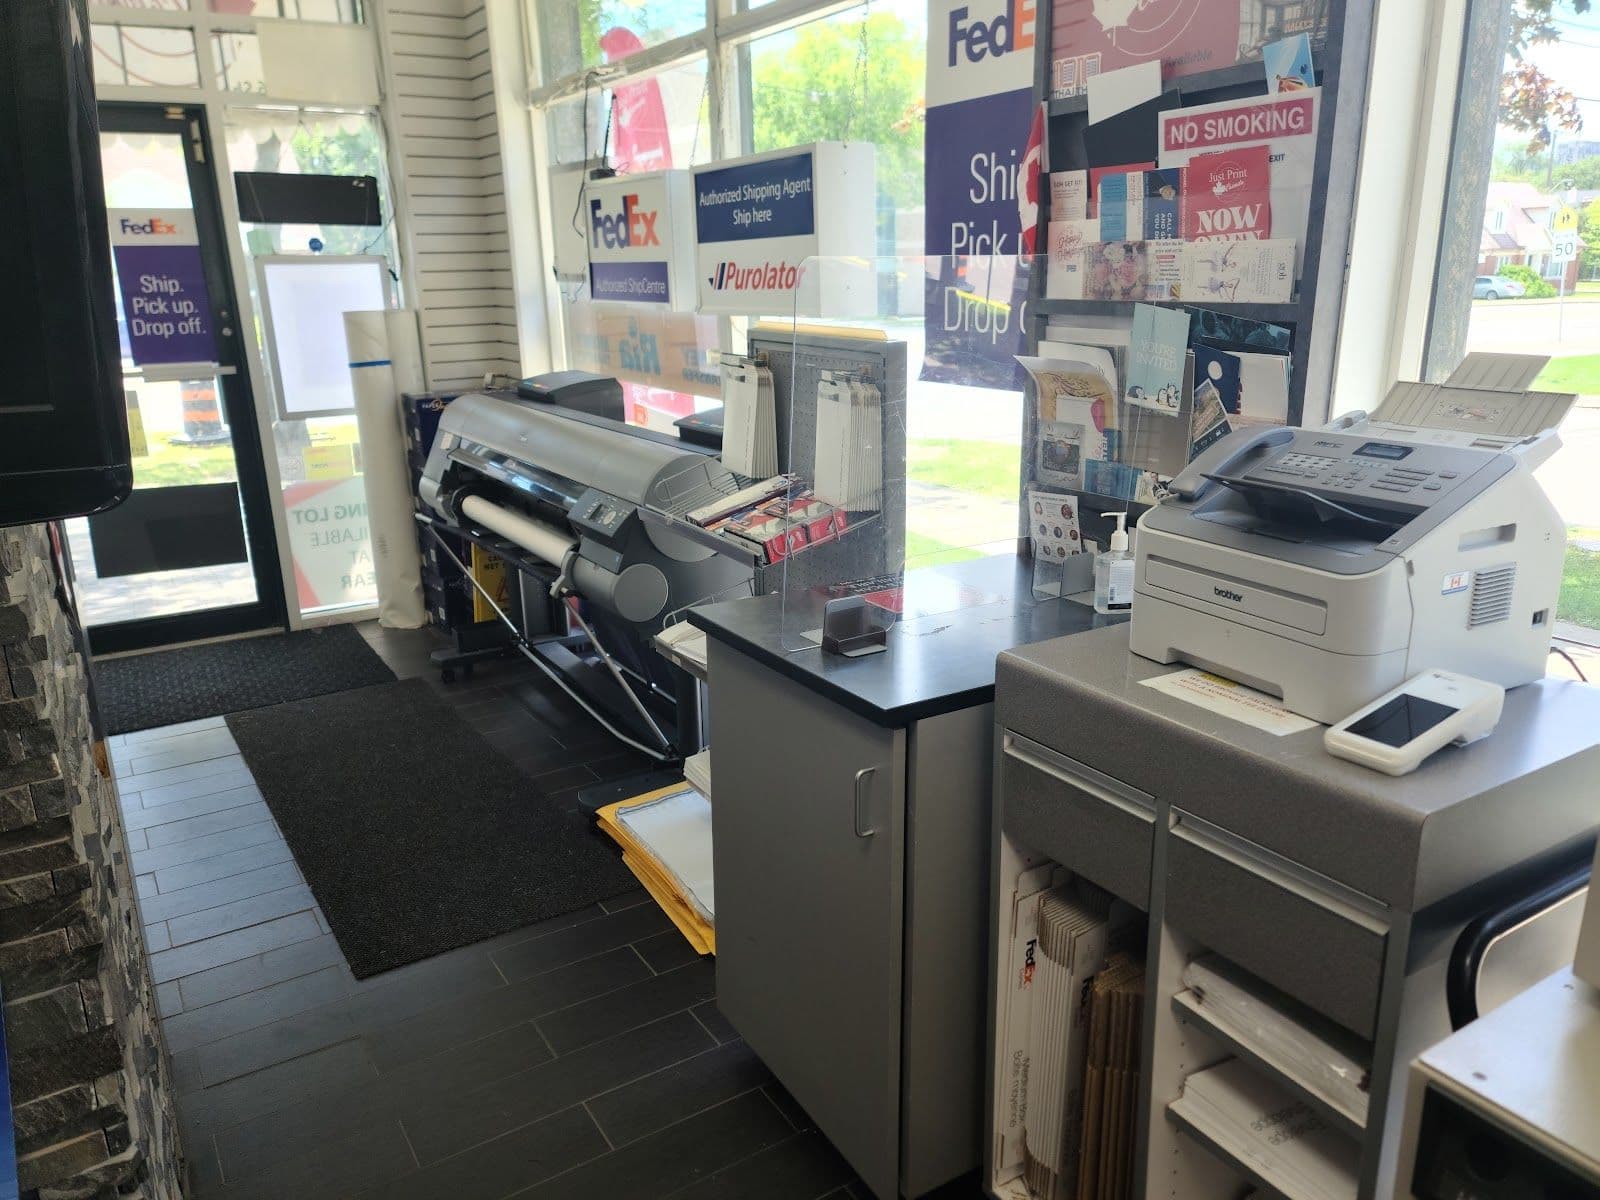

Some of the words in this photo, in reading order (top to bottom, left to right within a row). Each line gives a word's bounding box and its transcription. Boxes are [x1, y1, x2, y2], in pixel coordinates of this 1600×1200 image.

[948, 0, 1034, 67] FedE
[1170, 122, 1198, 145] NO
[1203, 106, 1305, 140] SMOKING
[1268, 153, 1286, 163] EXIT
[969, 149, 1023, 205] Shi
[1208, 172, 1225, 183] Just
[1227, 169, 1248, 180] Print
[699, 186, 742, 207] Authorized
[742, 181, 781, 204] Shipping
[782, 177, 812, 199] Agent
[120, 218, 177, 235] FedEx
[590, 193, 662, 250] FedEx
[732, 208, 752, 228] Ship
[752, 207, 773, 223] here
[1195, 203, 1263, 234] NOW
[951, 220, 1008, 270] Pick
[1555, 242, 1574, 257] 50
[139, 274, 185, 297] Ship.
[724, 261, 806, 291] Purolator
[132, 297, 169, 316] Pick
[171, 300, 199, 318] up.
[944, 286, 1010, 345] Drop
[132, 318, 175, 339] Drop
[178, 317, 207, 335] off.
[1213, 585, 1243, 603] brother
[1023, 938, 1037, 984] FedEx
